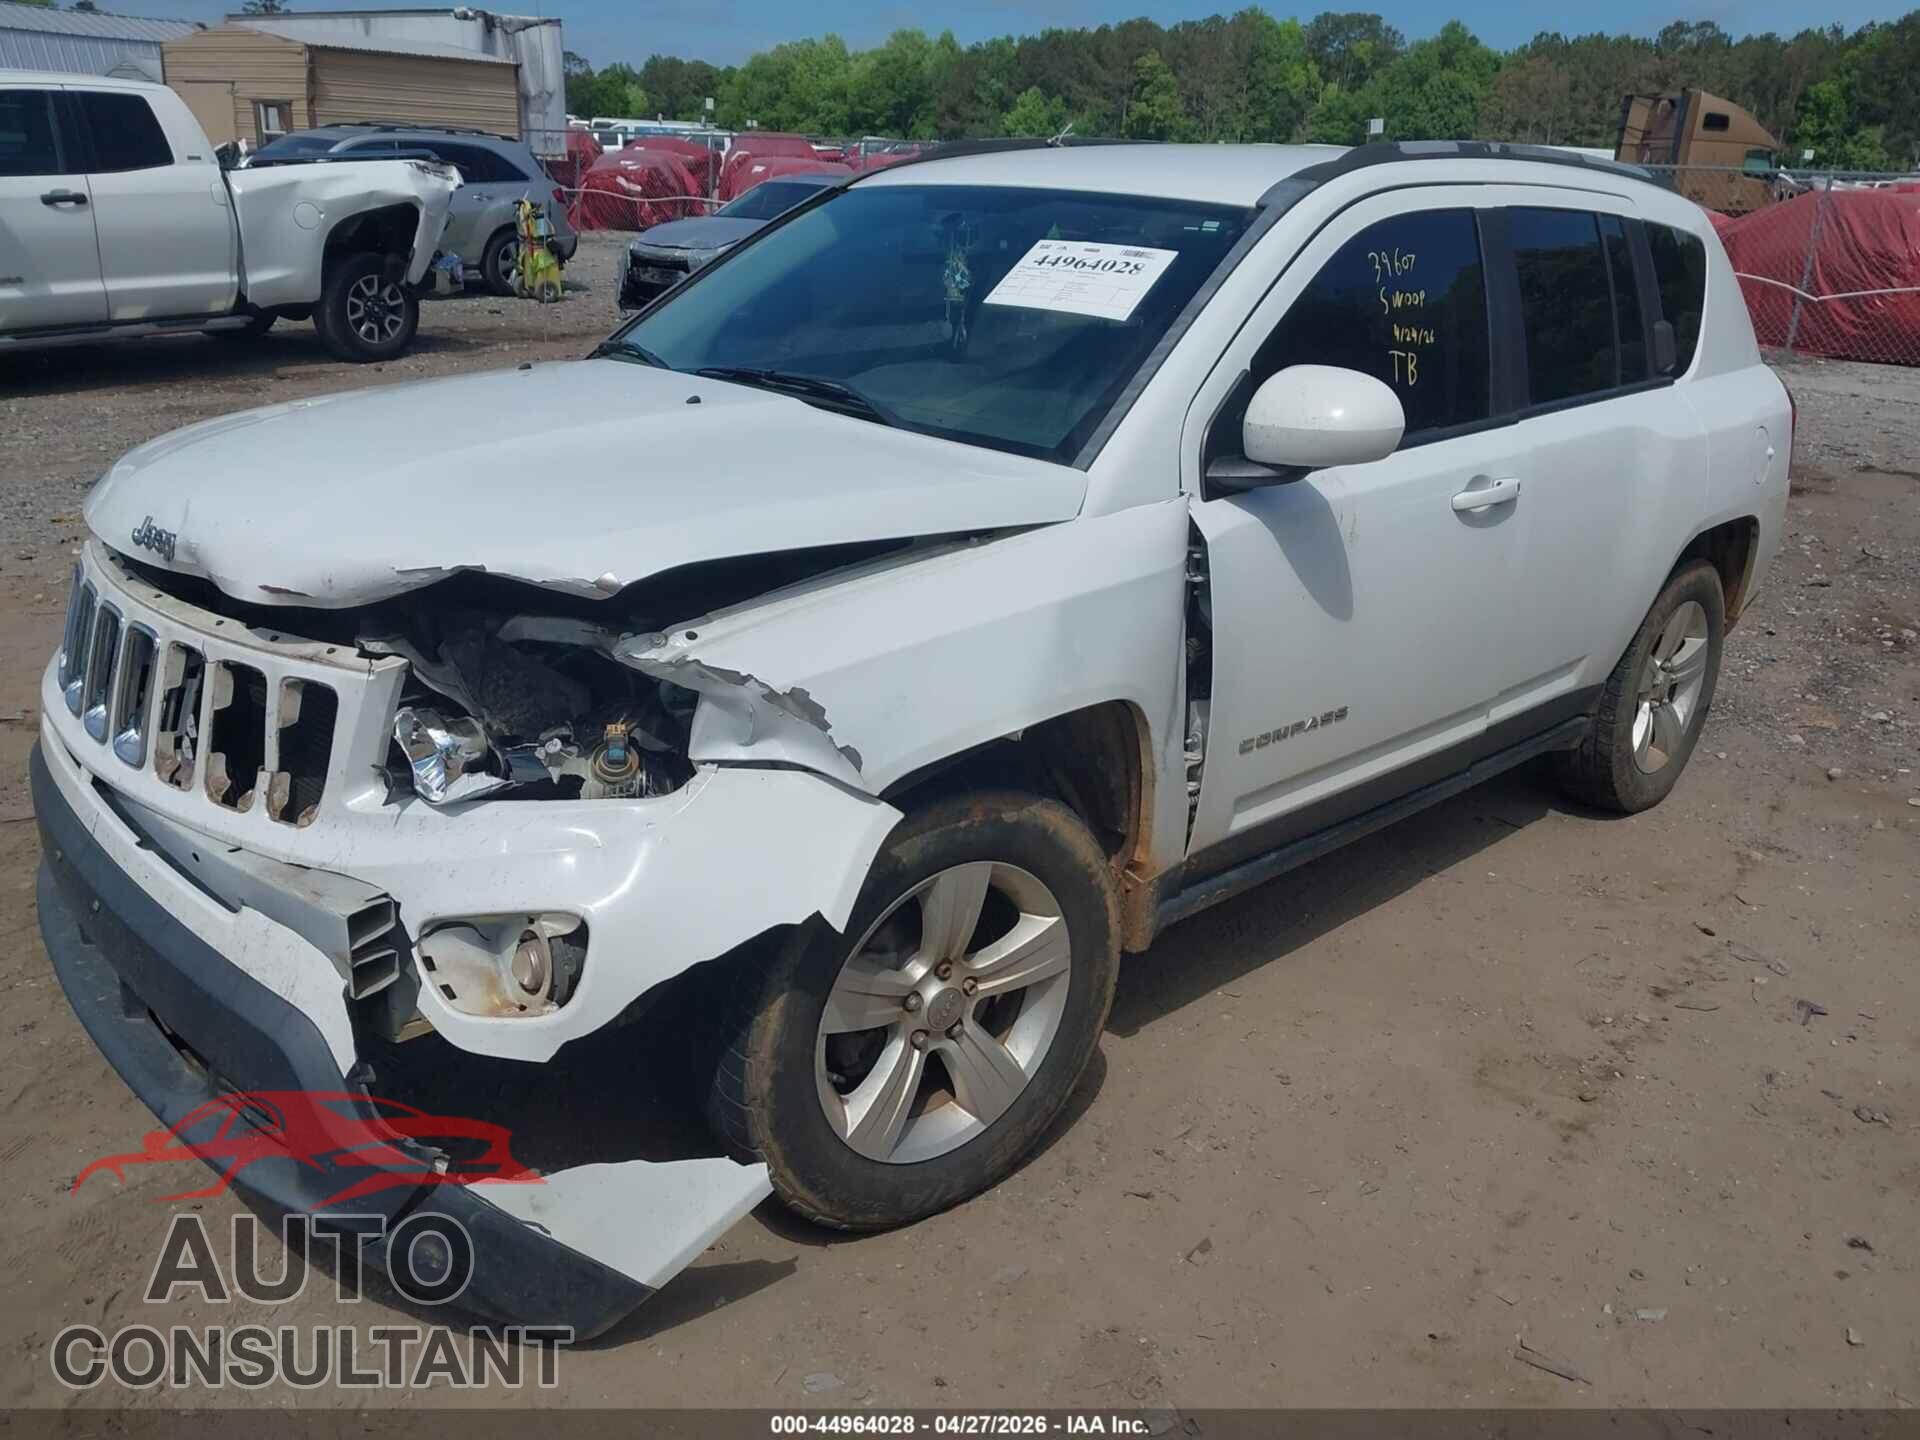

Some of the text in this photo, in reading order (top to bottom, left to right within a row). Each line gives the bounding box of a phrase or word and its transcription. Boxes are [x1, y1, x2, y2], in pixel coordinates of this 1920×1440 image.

[1033, 254, 1146, 276] 44964028
[1367, 247, 1416, 283] 39607
[131, 515, 177, 562] Jeep
[1239, 705, 1349, 754] COMPASS
